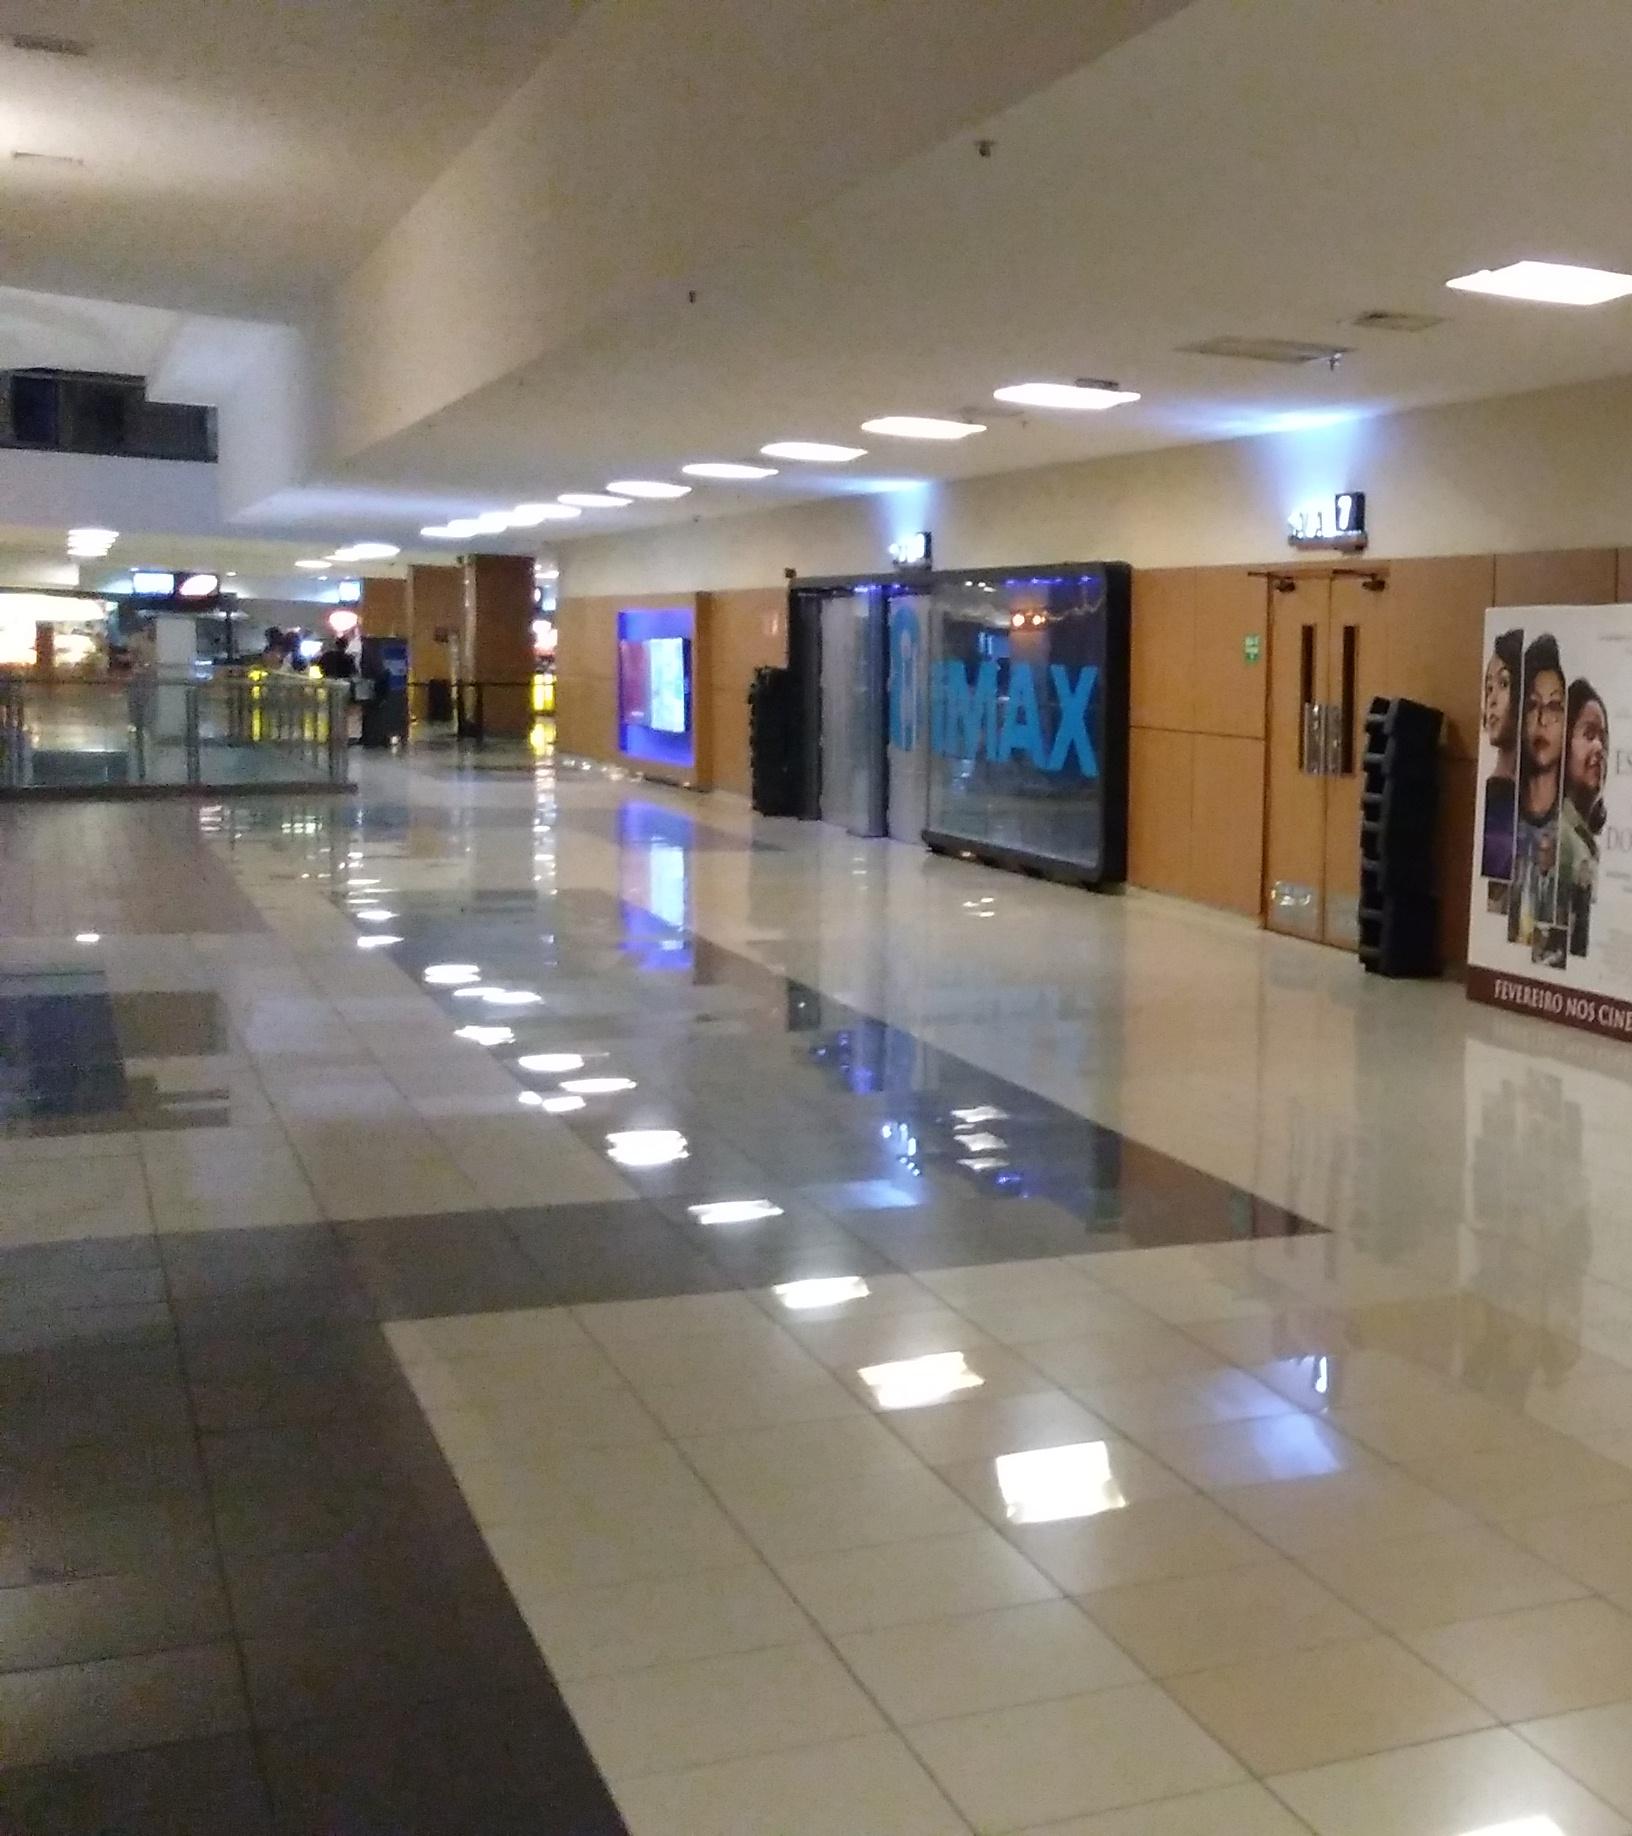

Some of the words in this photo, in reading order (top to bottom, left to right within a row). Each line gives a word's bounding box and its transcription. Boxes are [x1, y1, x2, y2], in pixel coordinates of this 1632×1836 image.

[929, 658, 1099, 779] IMAX
[1493, 980, 1564, 1015] FEVEREIRO
[1564, 996, 1596, 1023] NOS
